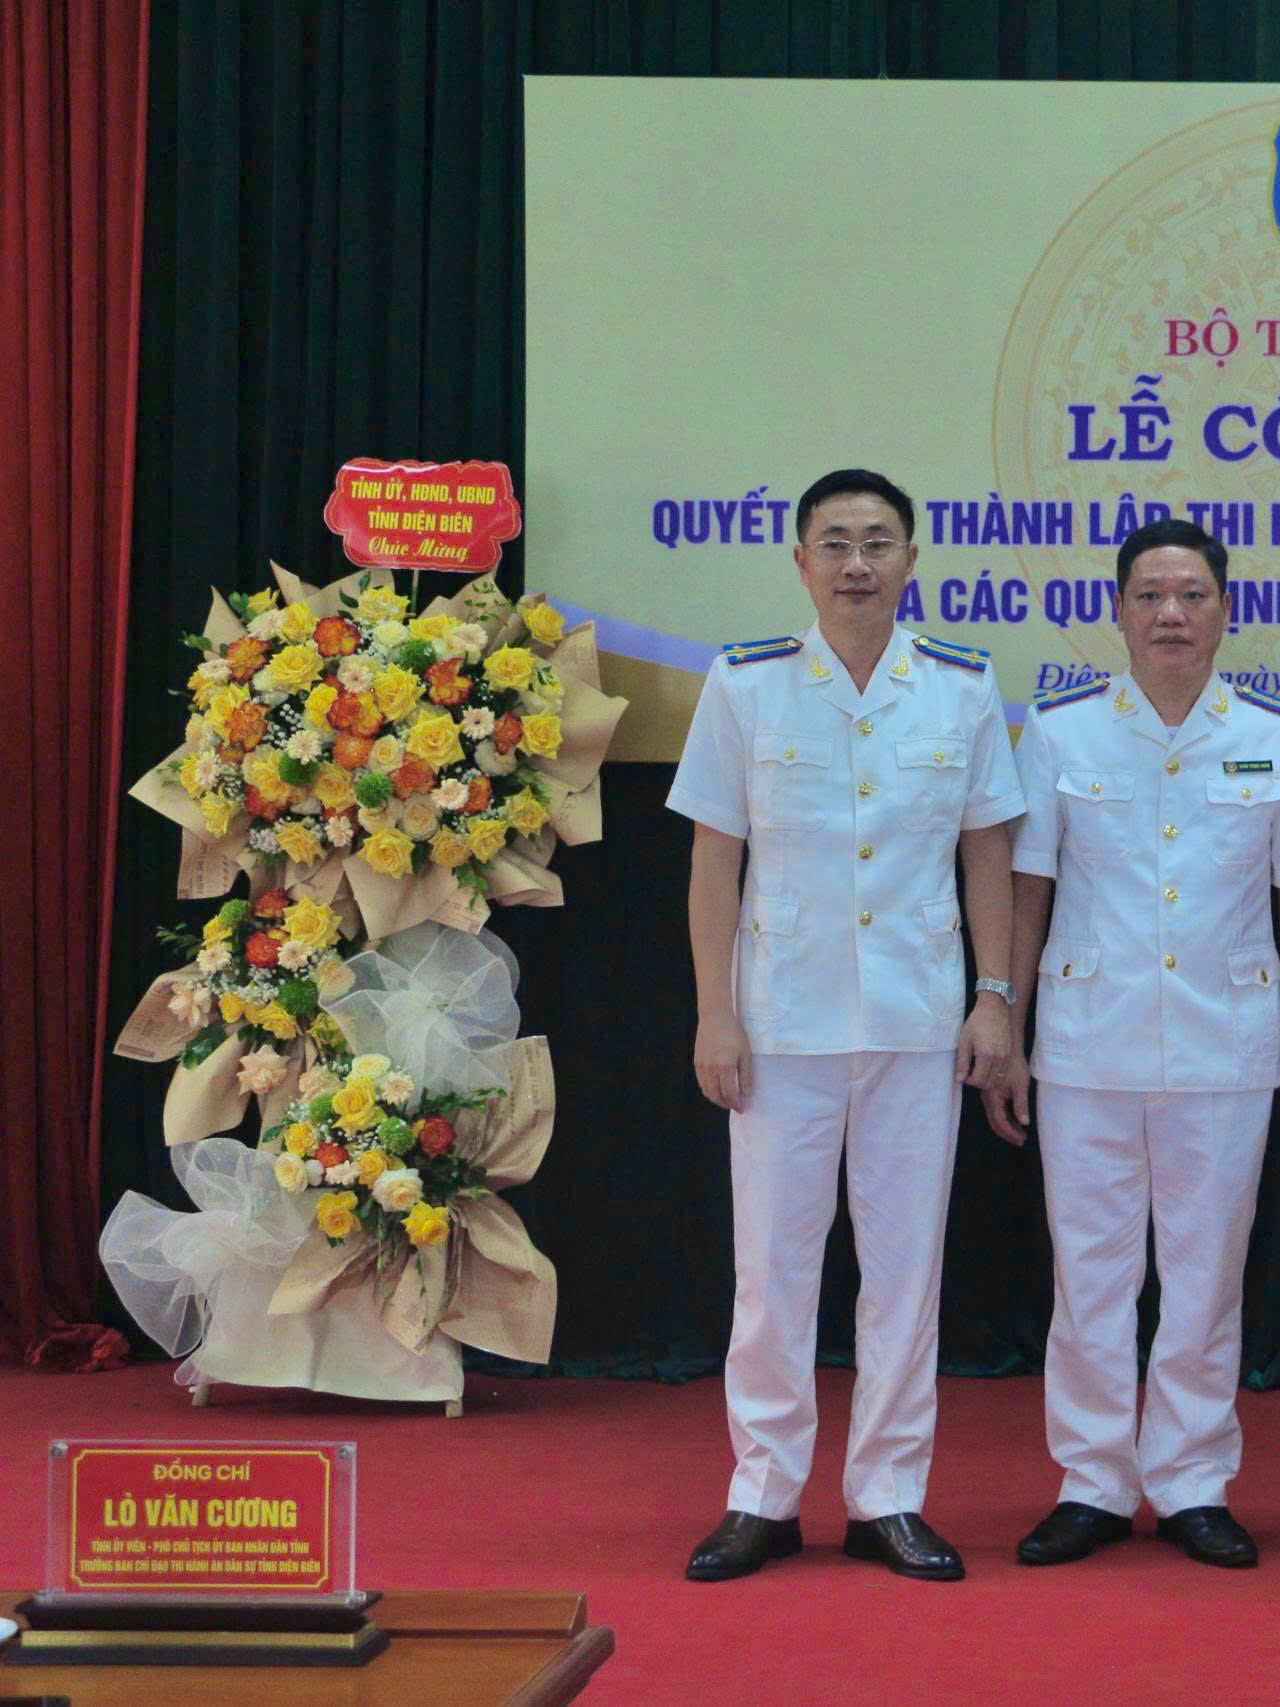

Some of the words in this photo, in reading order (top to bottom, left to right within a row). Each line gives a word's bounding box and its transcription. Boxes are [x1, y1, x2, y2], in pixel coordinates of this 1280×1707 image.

[1165, 307, 1239, 368] BỘ
[1068, 374, 1173, 461] LỄ
[351, 475, 381, 499] TỈNH
[411, 482, 453, 504] HĐND,
[457, 484, 496, 505] UBND
[368, 505, 399, 529] TỈNH
[402, 509, 436, 535] ĐIỆN
[439, 511, 473, 534] BIÊN
[652, 486, 791, 549] QUYẾT
[926, 493, 1073, 546] THÀNH
[1186, 503, 1254, 546] THI
[368, 535, 409, 557] Chúc
[413, 537, 469, 562] Mừng
[939, 569, 1028, 623] CÁC
[153, 1457, 212, 1481] ĐỒNG
[216, 1460, 251, 1481] CHÍ
[104, 1492, 137, 1527] LÒ
[145, 1493, 199, 1527] VĂN
[207, 1496, 298, 1528] CƯƠNG
